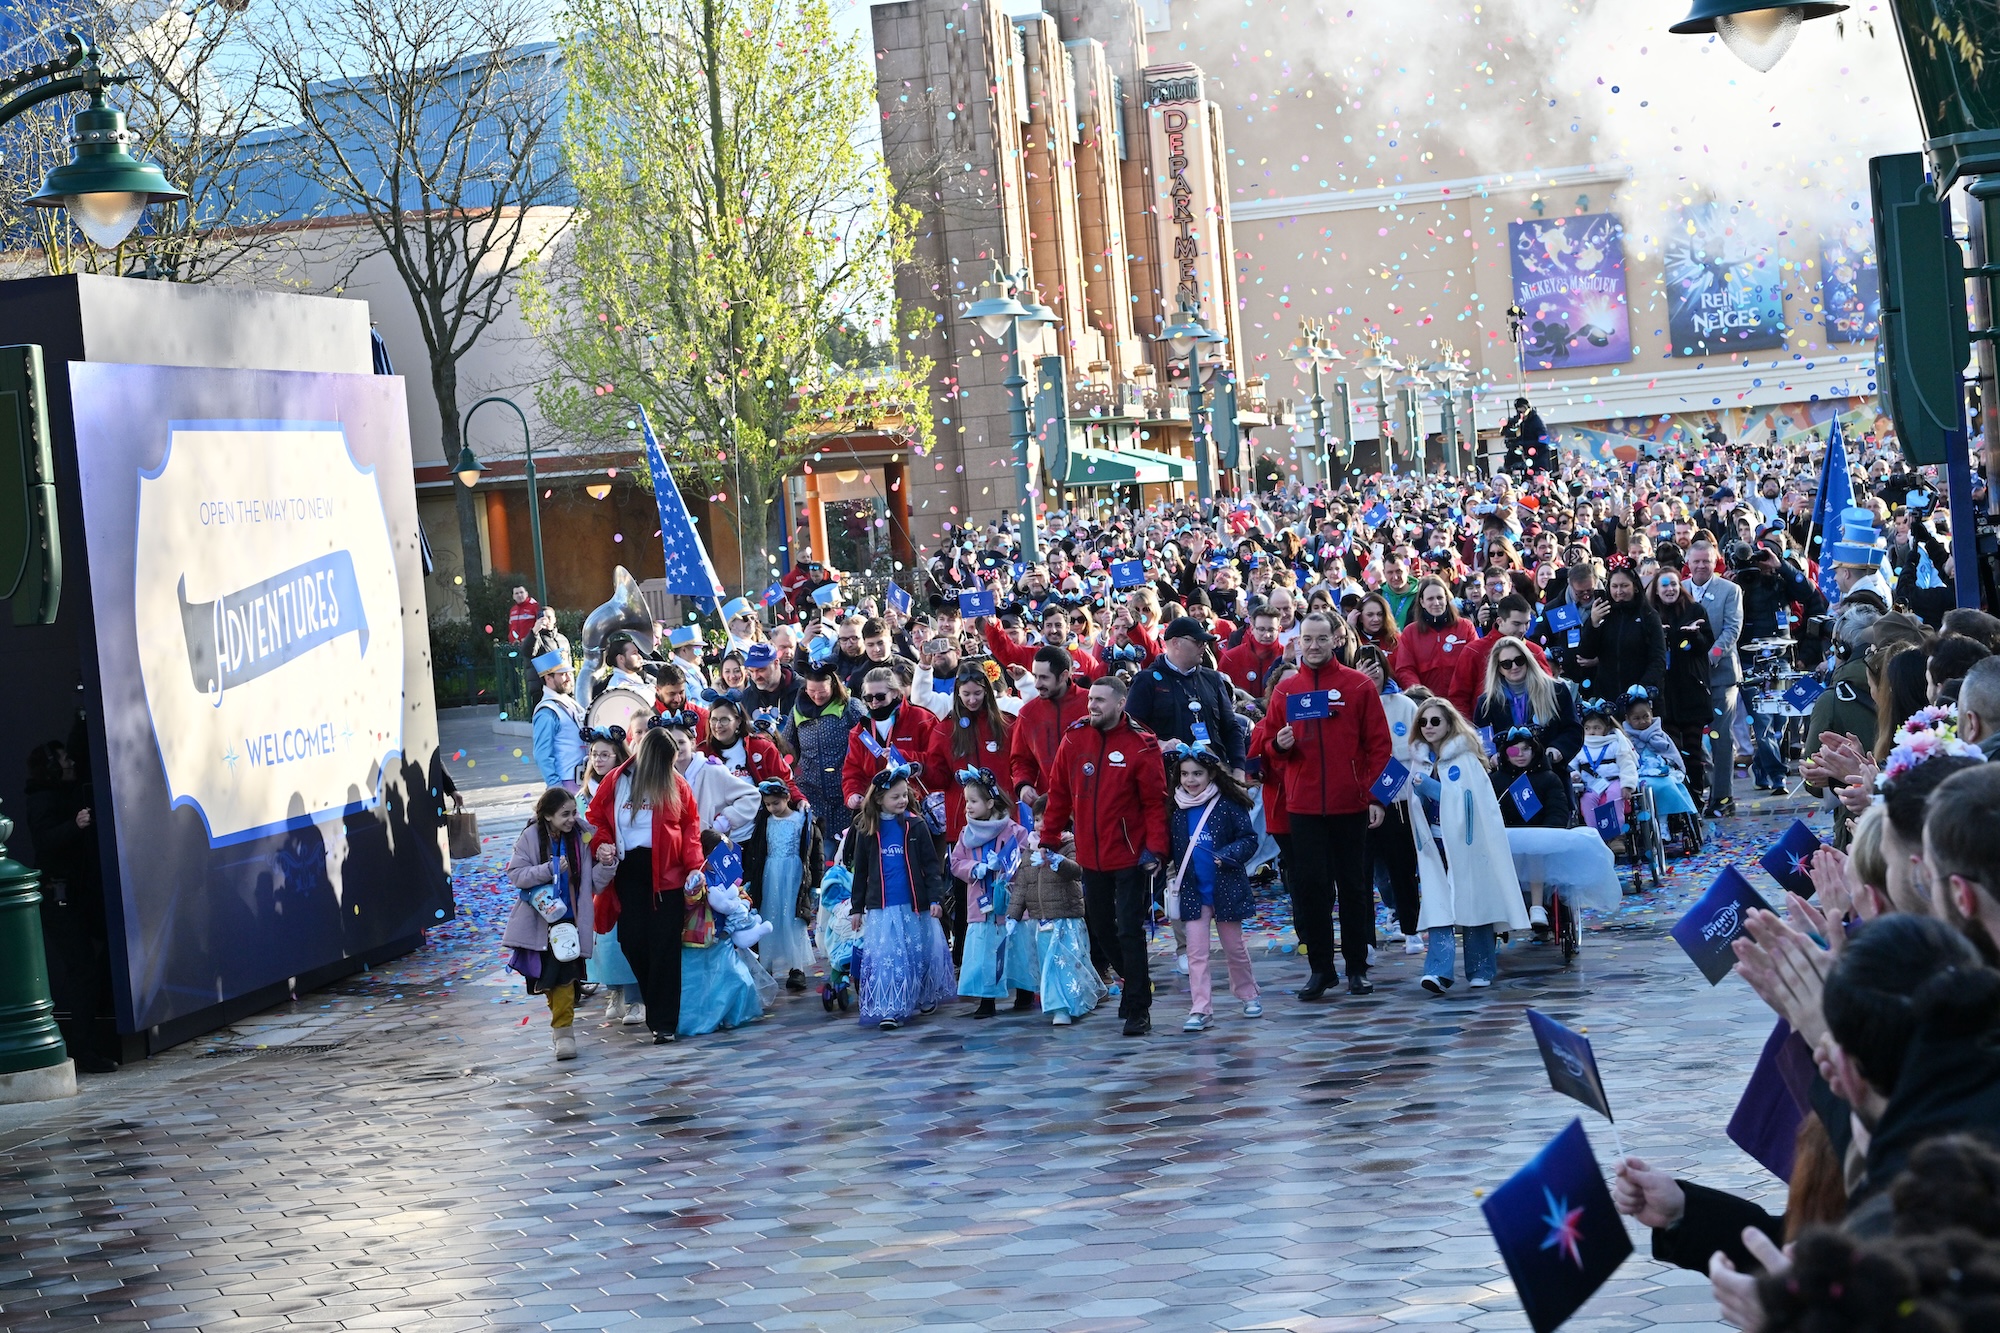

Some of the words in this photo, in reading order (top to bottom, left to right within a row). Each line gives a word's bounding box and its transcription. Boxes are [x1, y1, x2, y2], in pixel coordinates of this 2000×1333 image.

[1162, 109, 1200, 302] DEPARTMEN
[1519, 278, 1556, 304] MICKEY
[1569, 274, 1619, 293] MAGICIEN
[1701, 291, 1750, 309] REINE
[1691, 307, 1761, 333] NEIGES
[200, 501, 235, 525] OPEN
[237, 500, 261, 523] THE
[262, 499, 287, 521] WAY
[289, 498, 305, 520] TO
[308, 497, 333, 519] NEW
[208, 568, 340, 708] ADVENTURES
[245, 722, 336, 769] WELCOME!
[1703, 899, 1741, 942] ADVENTURE
